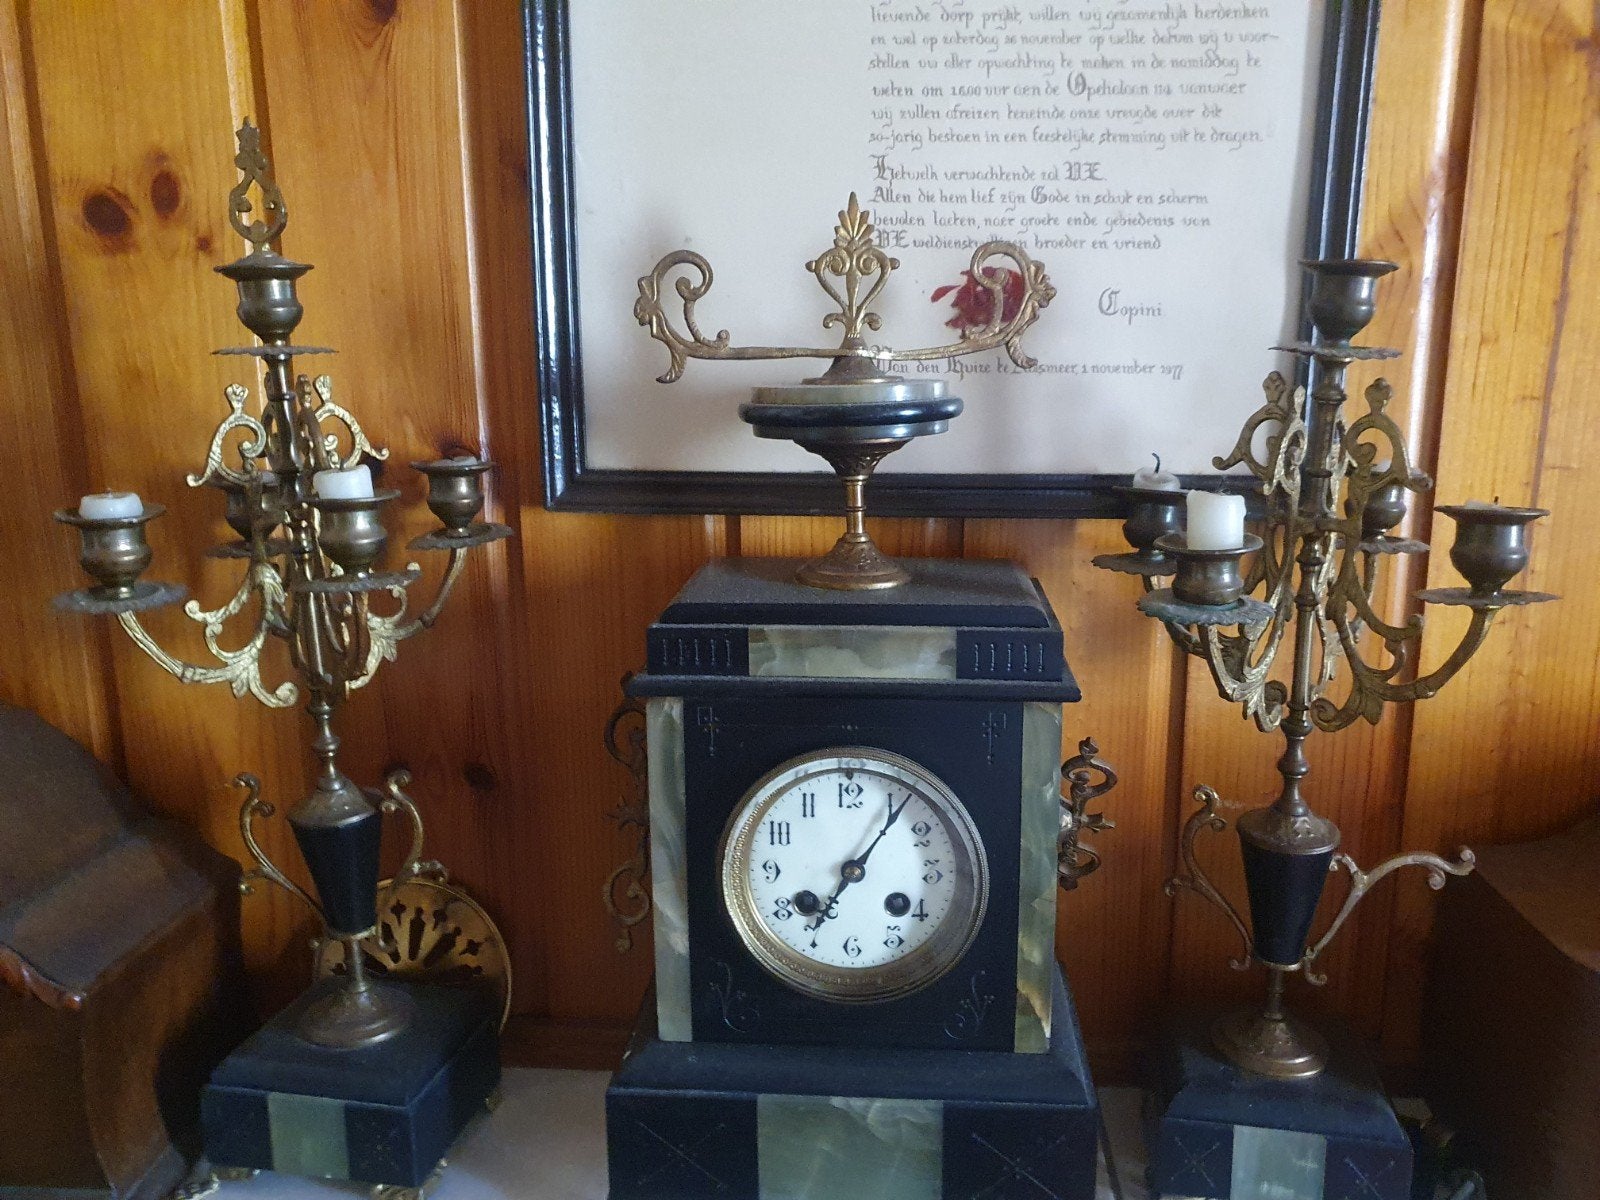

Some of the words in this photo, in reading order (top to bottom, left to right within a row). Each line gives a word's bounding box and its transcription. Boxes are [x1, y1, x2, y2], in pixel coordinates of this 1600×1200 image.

[940, 6, 974, 29] dorp
[1029, 5, 1070, 22] willen
[1080, 10, 1101, 30] wij
[1102, 4, 1187, 30] gezamenlijk
[1195, 4, 1270, 20] herdenken
[870, 35, 886, 45] en
[892, 31, 916, 45] wel
[922, 35, 938, 52] op
[943, 30, 999, 52] zaterdag
[1021, 29, 1082, 45] november
[1089, 34, 1105, 52] op
[1109, 30, 1145, 44] welke
[1152, 28, 1193, 44] datum
[1199, 33, 1218, 51] wij
[868, 53, 909, 70] stellen
[977, 51, 1055, 78] opwachting
[1082, 53, 1124, 68] maken
[1131, 57, 1145, 68] in
[1151, 53, 1164, 68] de
[1170, 49, 1239, 76] namiddag
[873, 80, 913, 96] weten
[921, 86, 943, 96] om
[985, 86, 1008, 96] uur
[1045, 81, 1060, 96] de
[871, 108, 892, 128] wij
[900, 104, 940, 119] zullen
[946, 103, 999, 119] afreizen
[1069, 109, 1100, 119] onze
[1106, 105, 1157, 124] vreugde
[1162, 109, 1195, 118] over
[986, 131, 1000, 142] in
[1004, 132, 1027, 142] een
[1032, 125, 1094, 151] feestelijke
[1099, 129, 1166, 150] stemming
[1170, 130, 1189, 142] uit
[943, 164, 1035, 181] verwachtende
[1041, 165, 1059, 181] zal
[868, 186, 910, 204] Allen
[918, 188, 935, 203] die
[940, 189, 967, 204] hem
[971, 187, 996, 203] lief
[1001, 191, 1026, 212] zijn
[1031, 185, 1070, 204] Gode
[1074, 192, 1090, 203] in
[1137, 194, 1153, 203] en
[1158, 189, 1208, 204] scherm
[1067, 212, 1097, 226] ende
[1102, 211, 1174, 235] gebiedenis
[1182, 217, 1210, 226] van
[1034, 233, 1085, 249] broeder
[1092, 240, 1106, 249] en
[1113, 234, 1161, 249] vriend
[1099, 287, 1162, 325] Copini
[916, 359, 940, 373] den
[1092, 359, 1156, 374] november
[1160, 365, 1183, 381] 1977
[802, 793, 815, 818] 11
[838, 782, 864, 809] 12
[769, 820, 791, 846] 10
[911, 821, 931, 847] 2
[762, 859, 781, 885] 9
[773, 897, 792, 921] 8
[911, 898, 928, 922] 4
[843, 936, 862, 958] 6
[883, 925, 905, 949] 5
